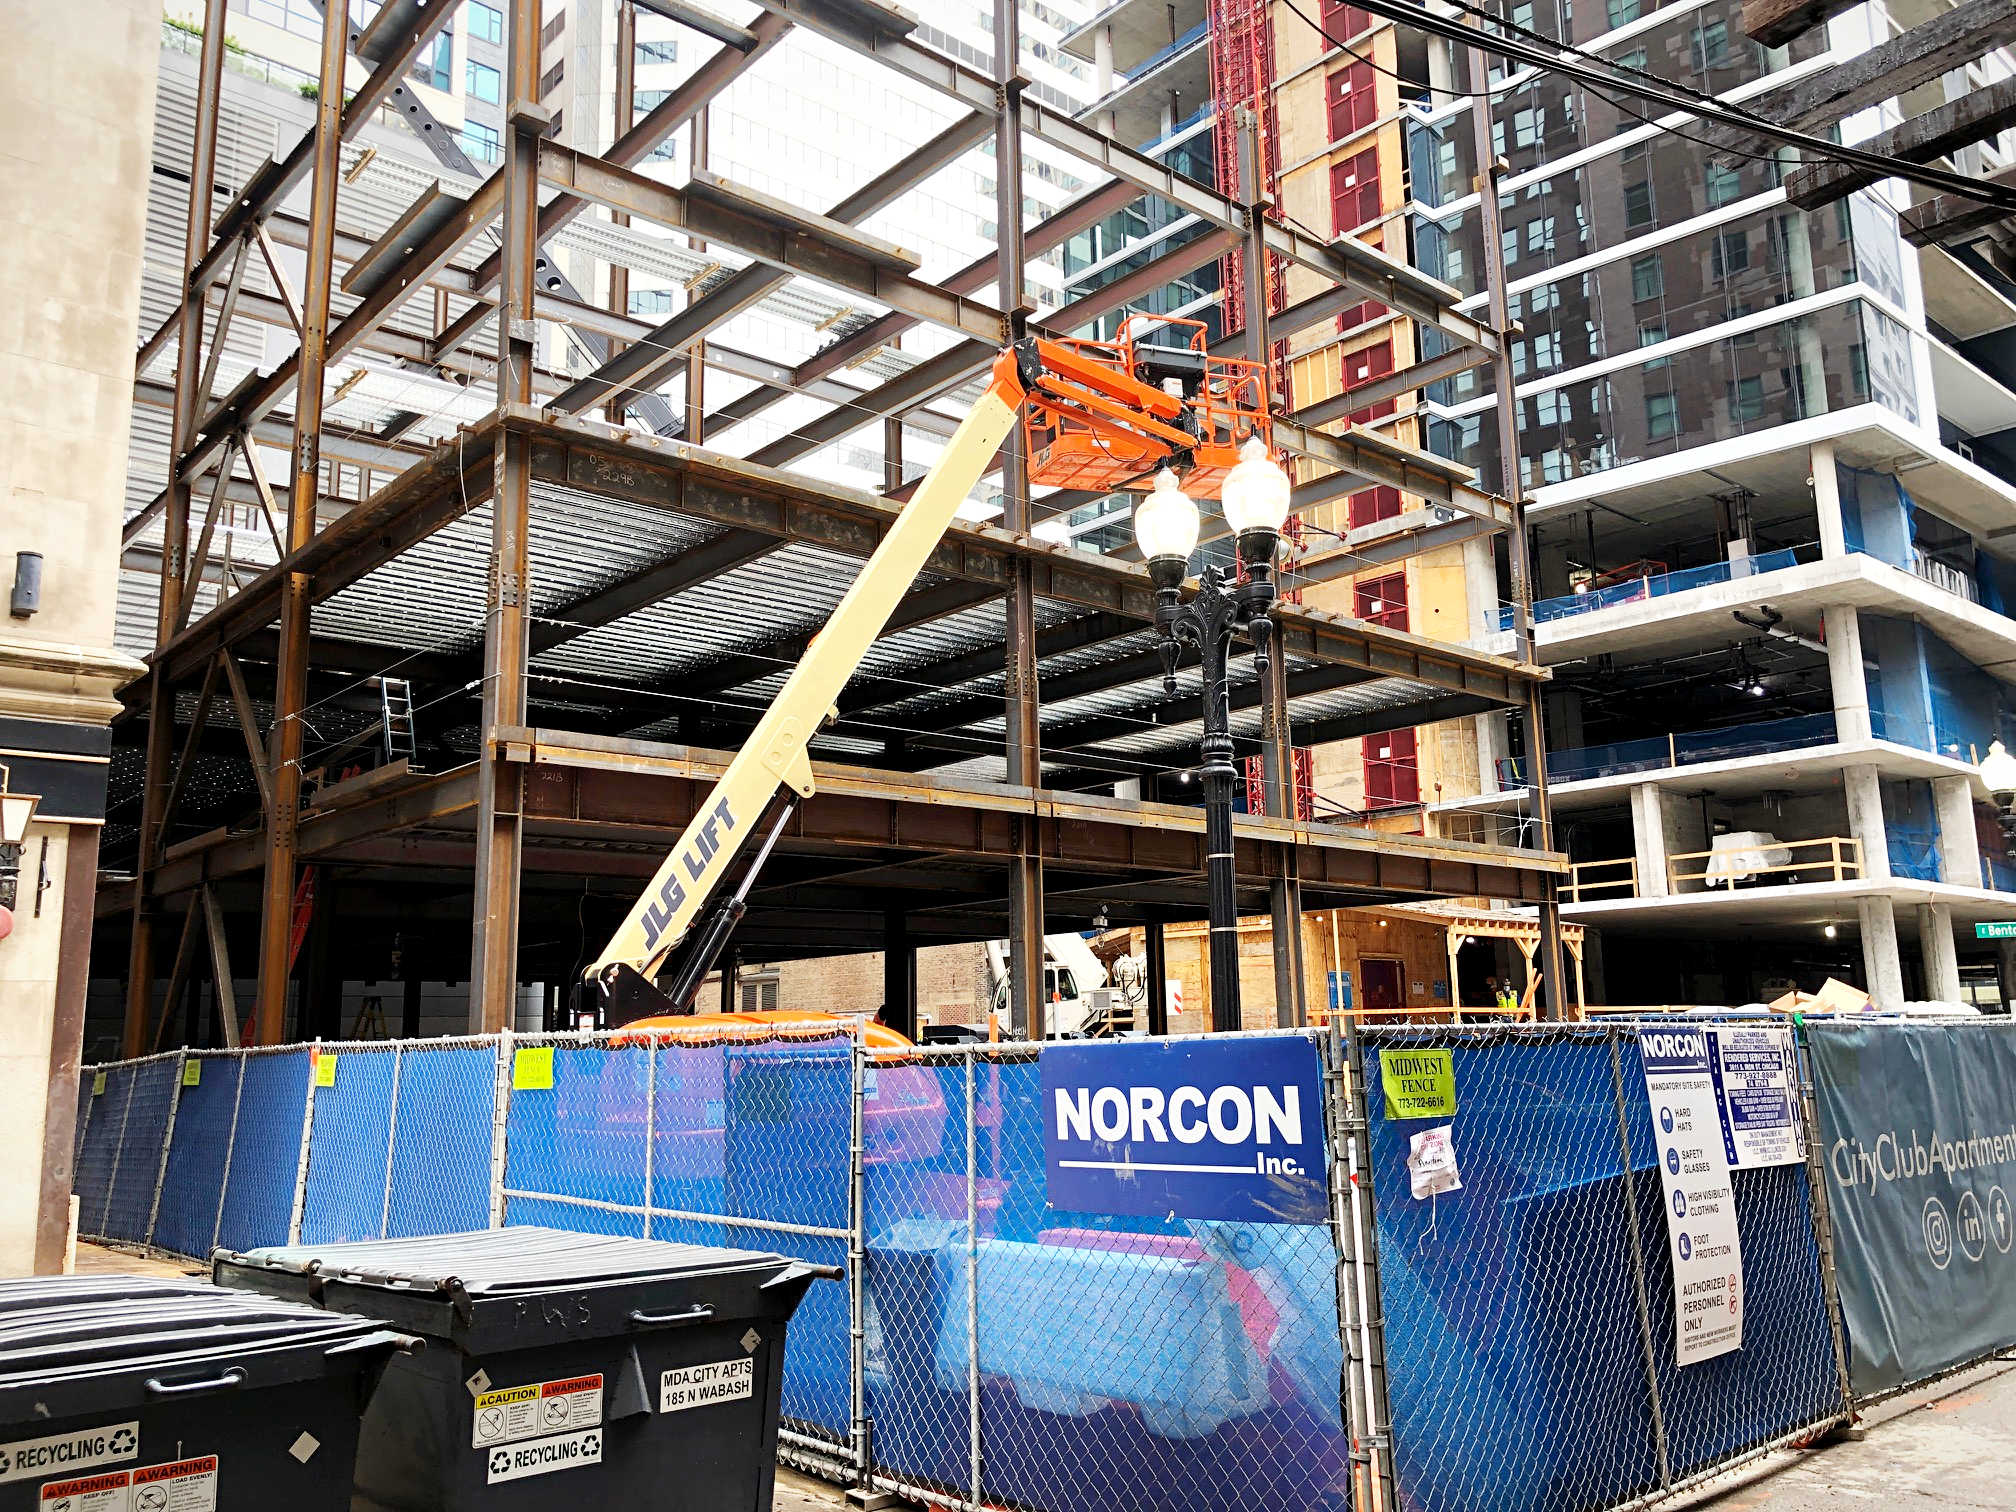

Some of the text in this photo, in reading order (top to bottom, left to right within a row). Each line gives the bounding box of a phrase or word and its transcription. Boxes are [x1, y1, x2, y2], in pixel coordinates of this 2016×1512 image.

[640, 796, 735, 951] JLG LIFT
[1640, 1033, 1706, 1058] NORCON
[1389, 1057, 1443, 1076] MIDWEST
[1402, 1078, 1437, 1093] FENCE
[1651, 1080, 1711, 1092] MANDATORY SITE SAFETY
[1781, 1031, 1806, 1157] WARNING
[1398, 1096, 1445, 1109] 773-722-6616
[1054, 1084, 1304, 1144] NORCON
[1675, 1108, 1691, 1118] HARD
[1677, 1121, 1692, 1132] HATS
[1681, 1148, 1703, 1160] SAFETY
[1256, 1152, 1305, 1176] Inc.
[1684, 1162, 1710, 1175] GLASSES
[1688, 1188, 1730, 1203] HIGH VISIBILITY
[1689, 1203, 1720, 1218] CLOTHING
[1693, 1233, 1710, 1246] FOOT
[1695, 1245, 1731, 1260] PROTECTION
[1683, 1277, 1726, 1297] AUTHORIZED
[1684, 1295, 1725, 1314] PERSONNEL
[1684, 1317, 1703, 1332] ONLY
[664, 1360, 752, 1387] MDA CITY APTS
[552, 1378, 600, 1393] WARNING
[665, 1379, 749, 1407] 185 N WABASH
[487, 1388, 536, 1405] CAUTION
[16, 1436, 105, 1470] RECYCLING
[515, 1441, 578, 1469] RECYCLING
[146, 1459, 213, 1481] WARNING
[56, 1474, 126, 1496] WARNING
